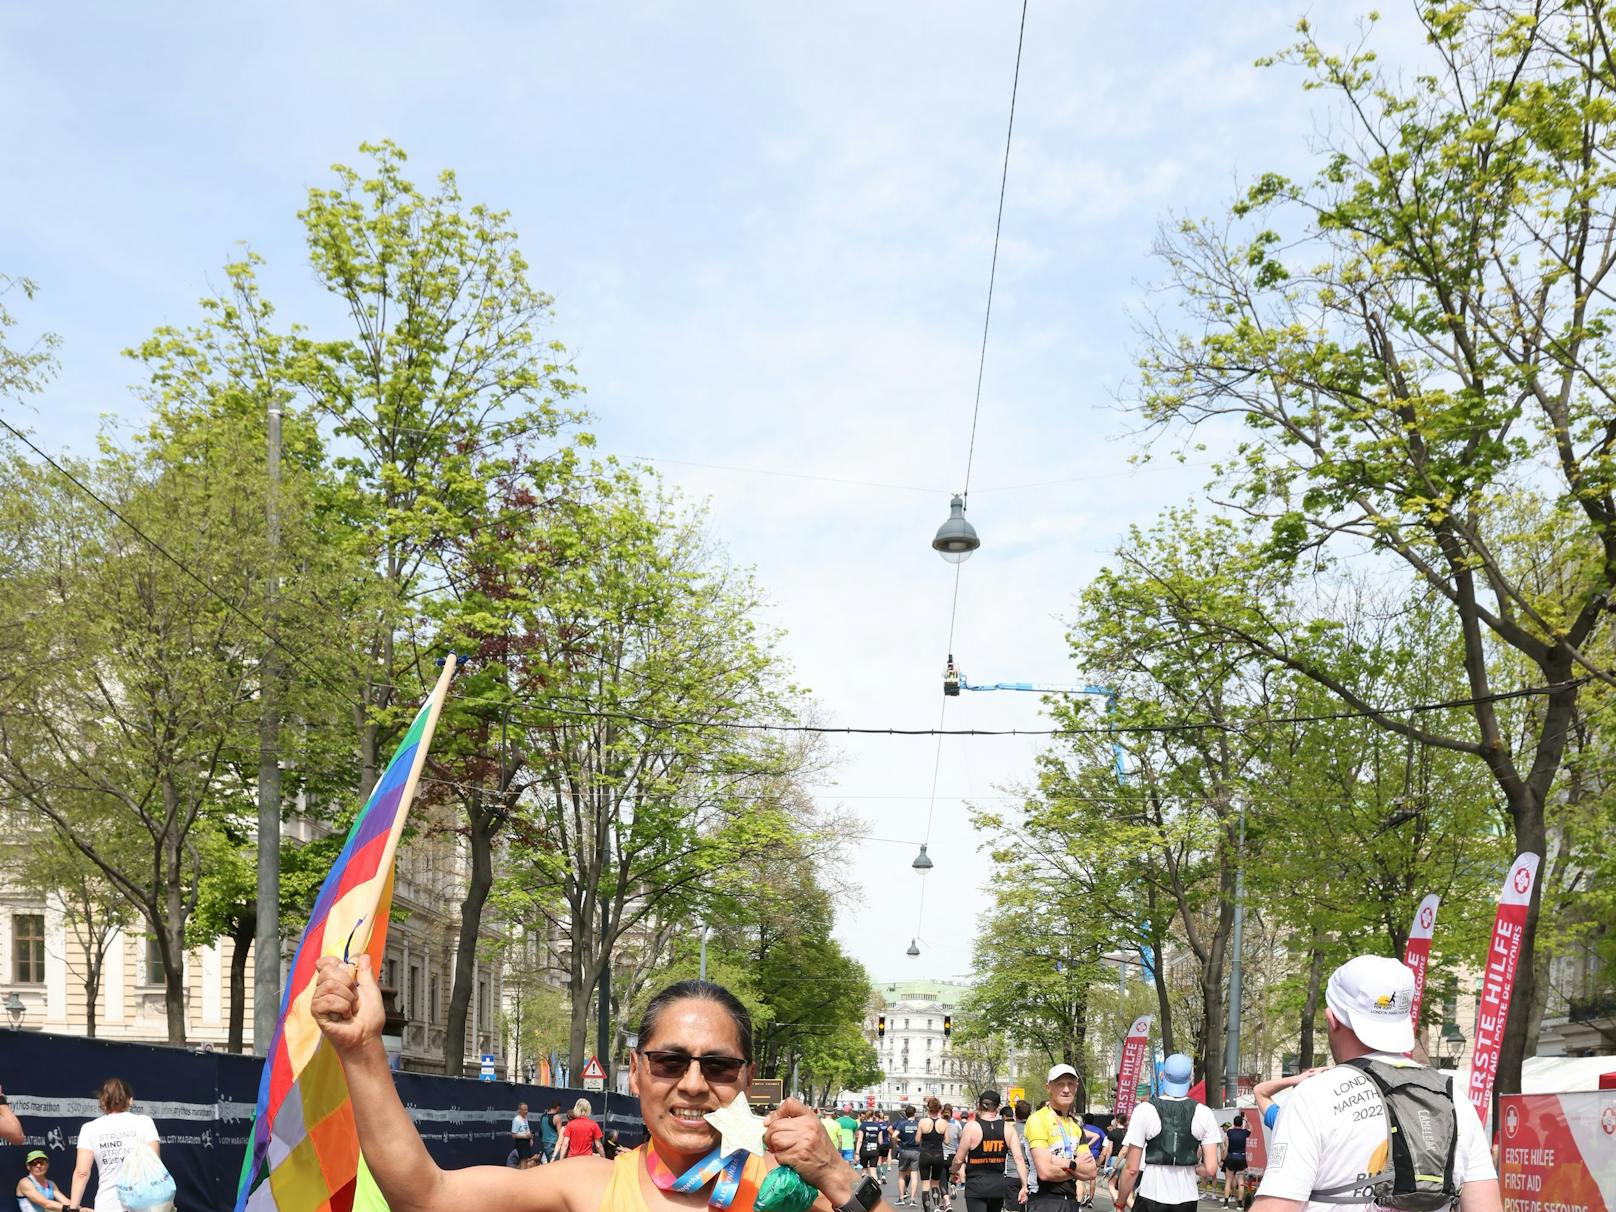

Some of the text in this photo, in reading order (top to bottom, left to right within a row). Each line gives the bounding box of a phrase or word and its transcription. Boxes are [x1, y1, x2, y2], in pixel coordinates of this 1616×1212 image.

[1506, 925, 1522, 981] SECOURS
[1502, 983, 1511, 1000] DE
[1470, 919, 1513, 1107] ERSTE HILFE
[1494, 1002, 1508, 1041] POSTE
[1489, 1051, 1498, 1073] AID
[1116, 1043, 1137, 1114] ERSTE HILFE
[1333, 1075, 1367, 1097] LOND
[1483, 1074, 1495, 1108] FIRST
[31, 1102, 60, 1113] marathon
[1333, 1089, 1378, 1116] MARATH
[1352, 1104, 1384, 1122] 2022
[23, 1136, 46, 1146] RATHON
[99, 1130, 137, 1141] STRONG
[100, 1140, 123, 1149] MIND
[166, 1136, 177, 1144] CITY
[178, 1136, 201, 1145] MARATHON
[982, 1140, 1005, 1152] WTF
[1505, 1148, 1554, 1166] ERSTE HILFE
[1504, 1173, 1541, 1192] FIRST AID
